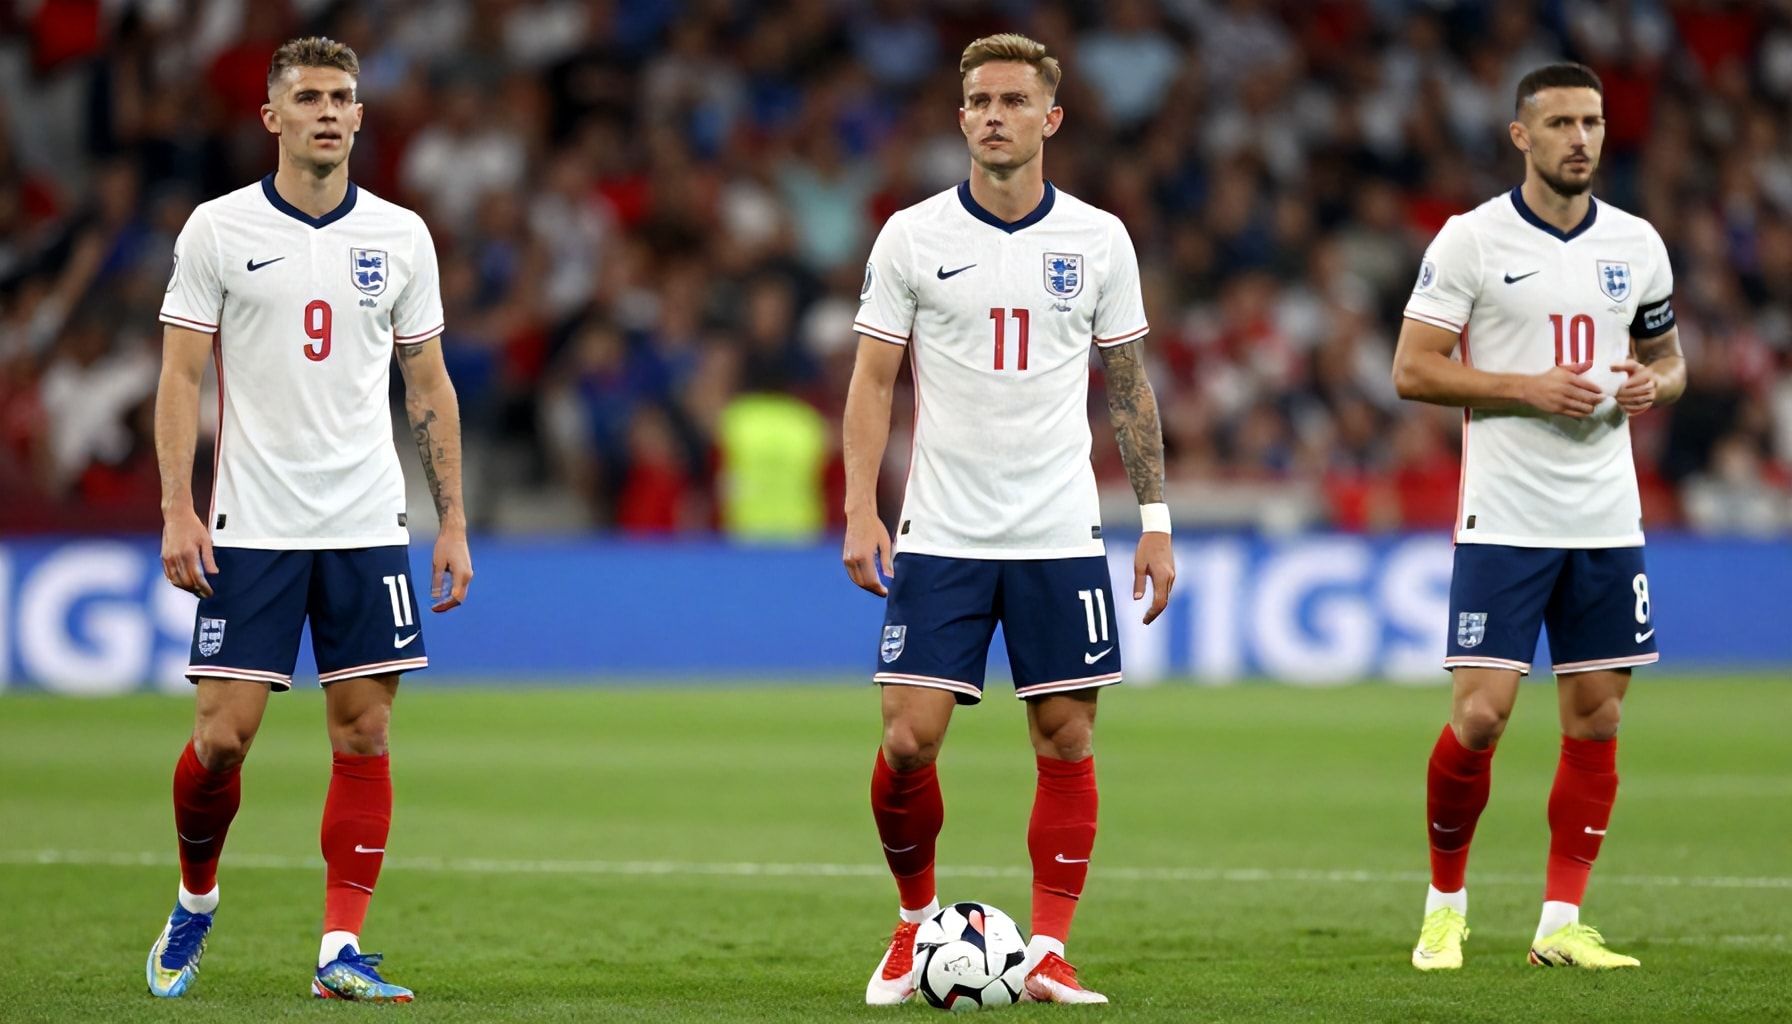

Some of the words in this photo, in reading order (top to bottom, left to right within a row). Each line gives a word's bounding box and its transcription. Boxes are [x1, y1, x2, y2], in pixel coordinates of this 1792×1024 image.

[303, 299, 333, 362] 9
[989, 307, 1030, 371] 11
[1549, 313, 1595, 375] 10
[382, 573, 414, 627] 11
[1078, 588, 1109, 643] 11
[1632, 573, 1650, 624] 8
